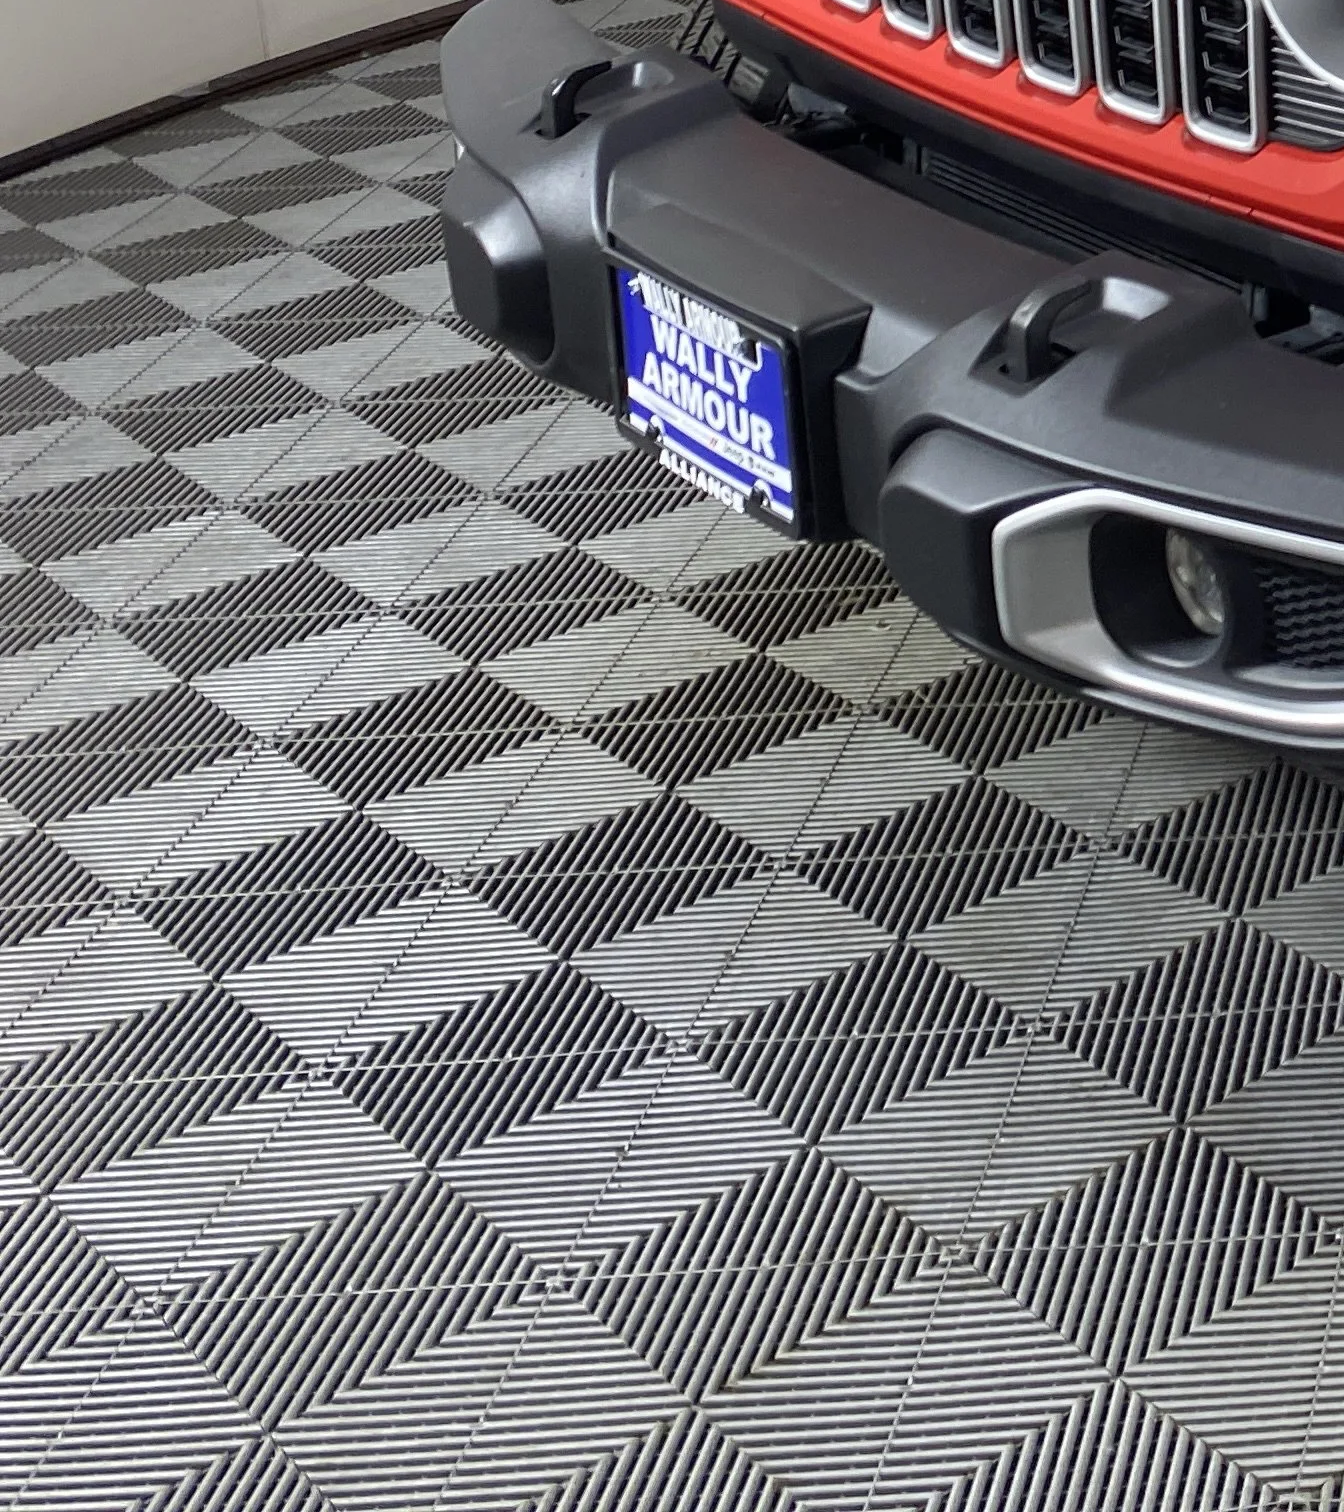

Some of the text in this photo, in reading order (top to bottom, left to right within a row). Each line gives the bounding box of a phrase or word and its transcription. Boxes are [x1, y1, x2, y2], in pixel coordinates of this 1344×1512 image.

[650, 314, 754, 404] WALLY
[642, 351, 776, 461] ARMOUR
[659, 448, 745, 514] ALLIANCE
